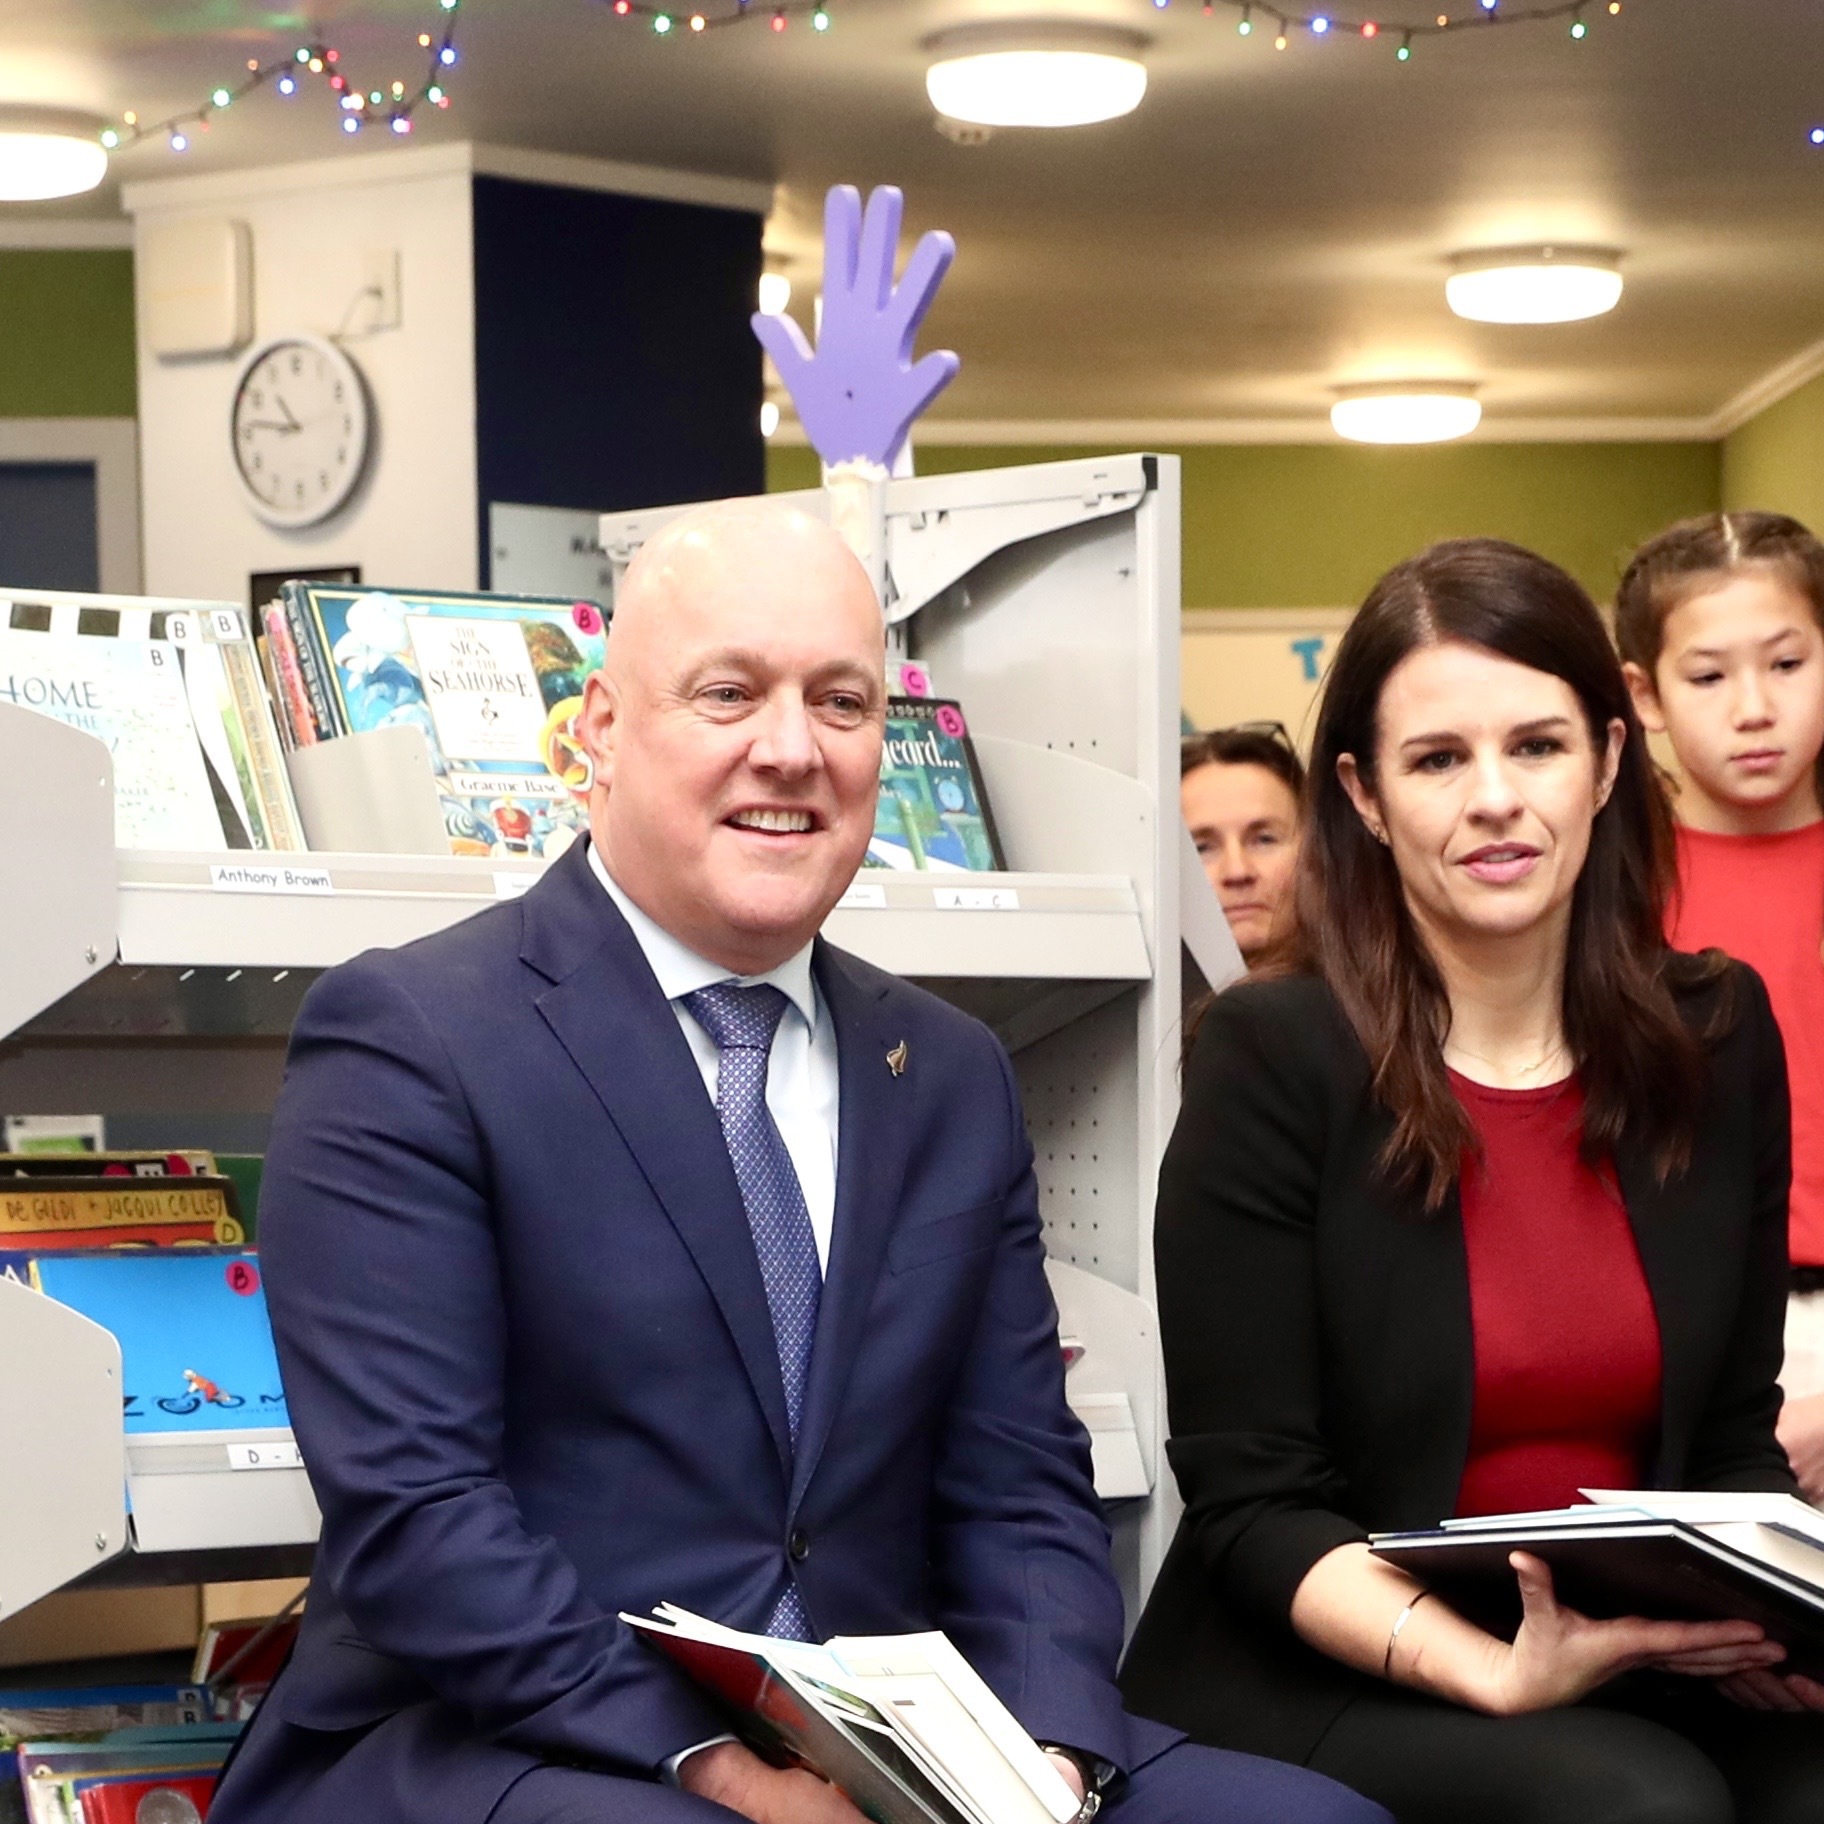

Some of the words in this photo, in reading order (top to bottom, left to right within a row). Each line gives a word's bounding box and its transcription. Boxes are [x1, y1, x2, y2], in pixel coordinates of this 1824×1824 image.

[172, 621, 188, 639] B
[218, 616, 232, 632] B
[149, 649, 165, 667] B
[428, 670, 534, 698] SEAHORSE
[217, 868, 278, 887] Anthony
[284, 871, 329, 888] Brown
[220, 1223, 236, 1242] D
[232, 1268, 249, 1289] B
[249, 1450, 260, 1464] D
